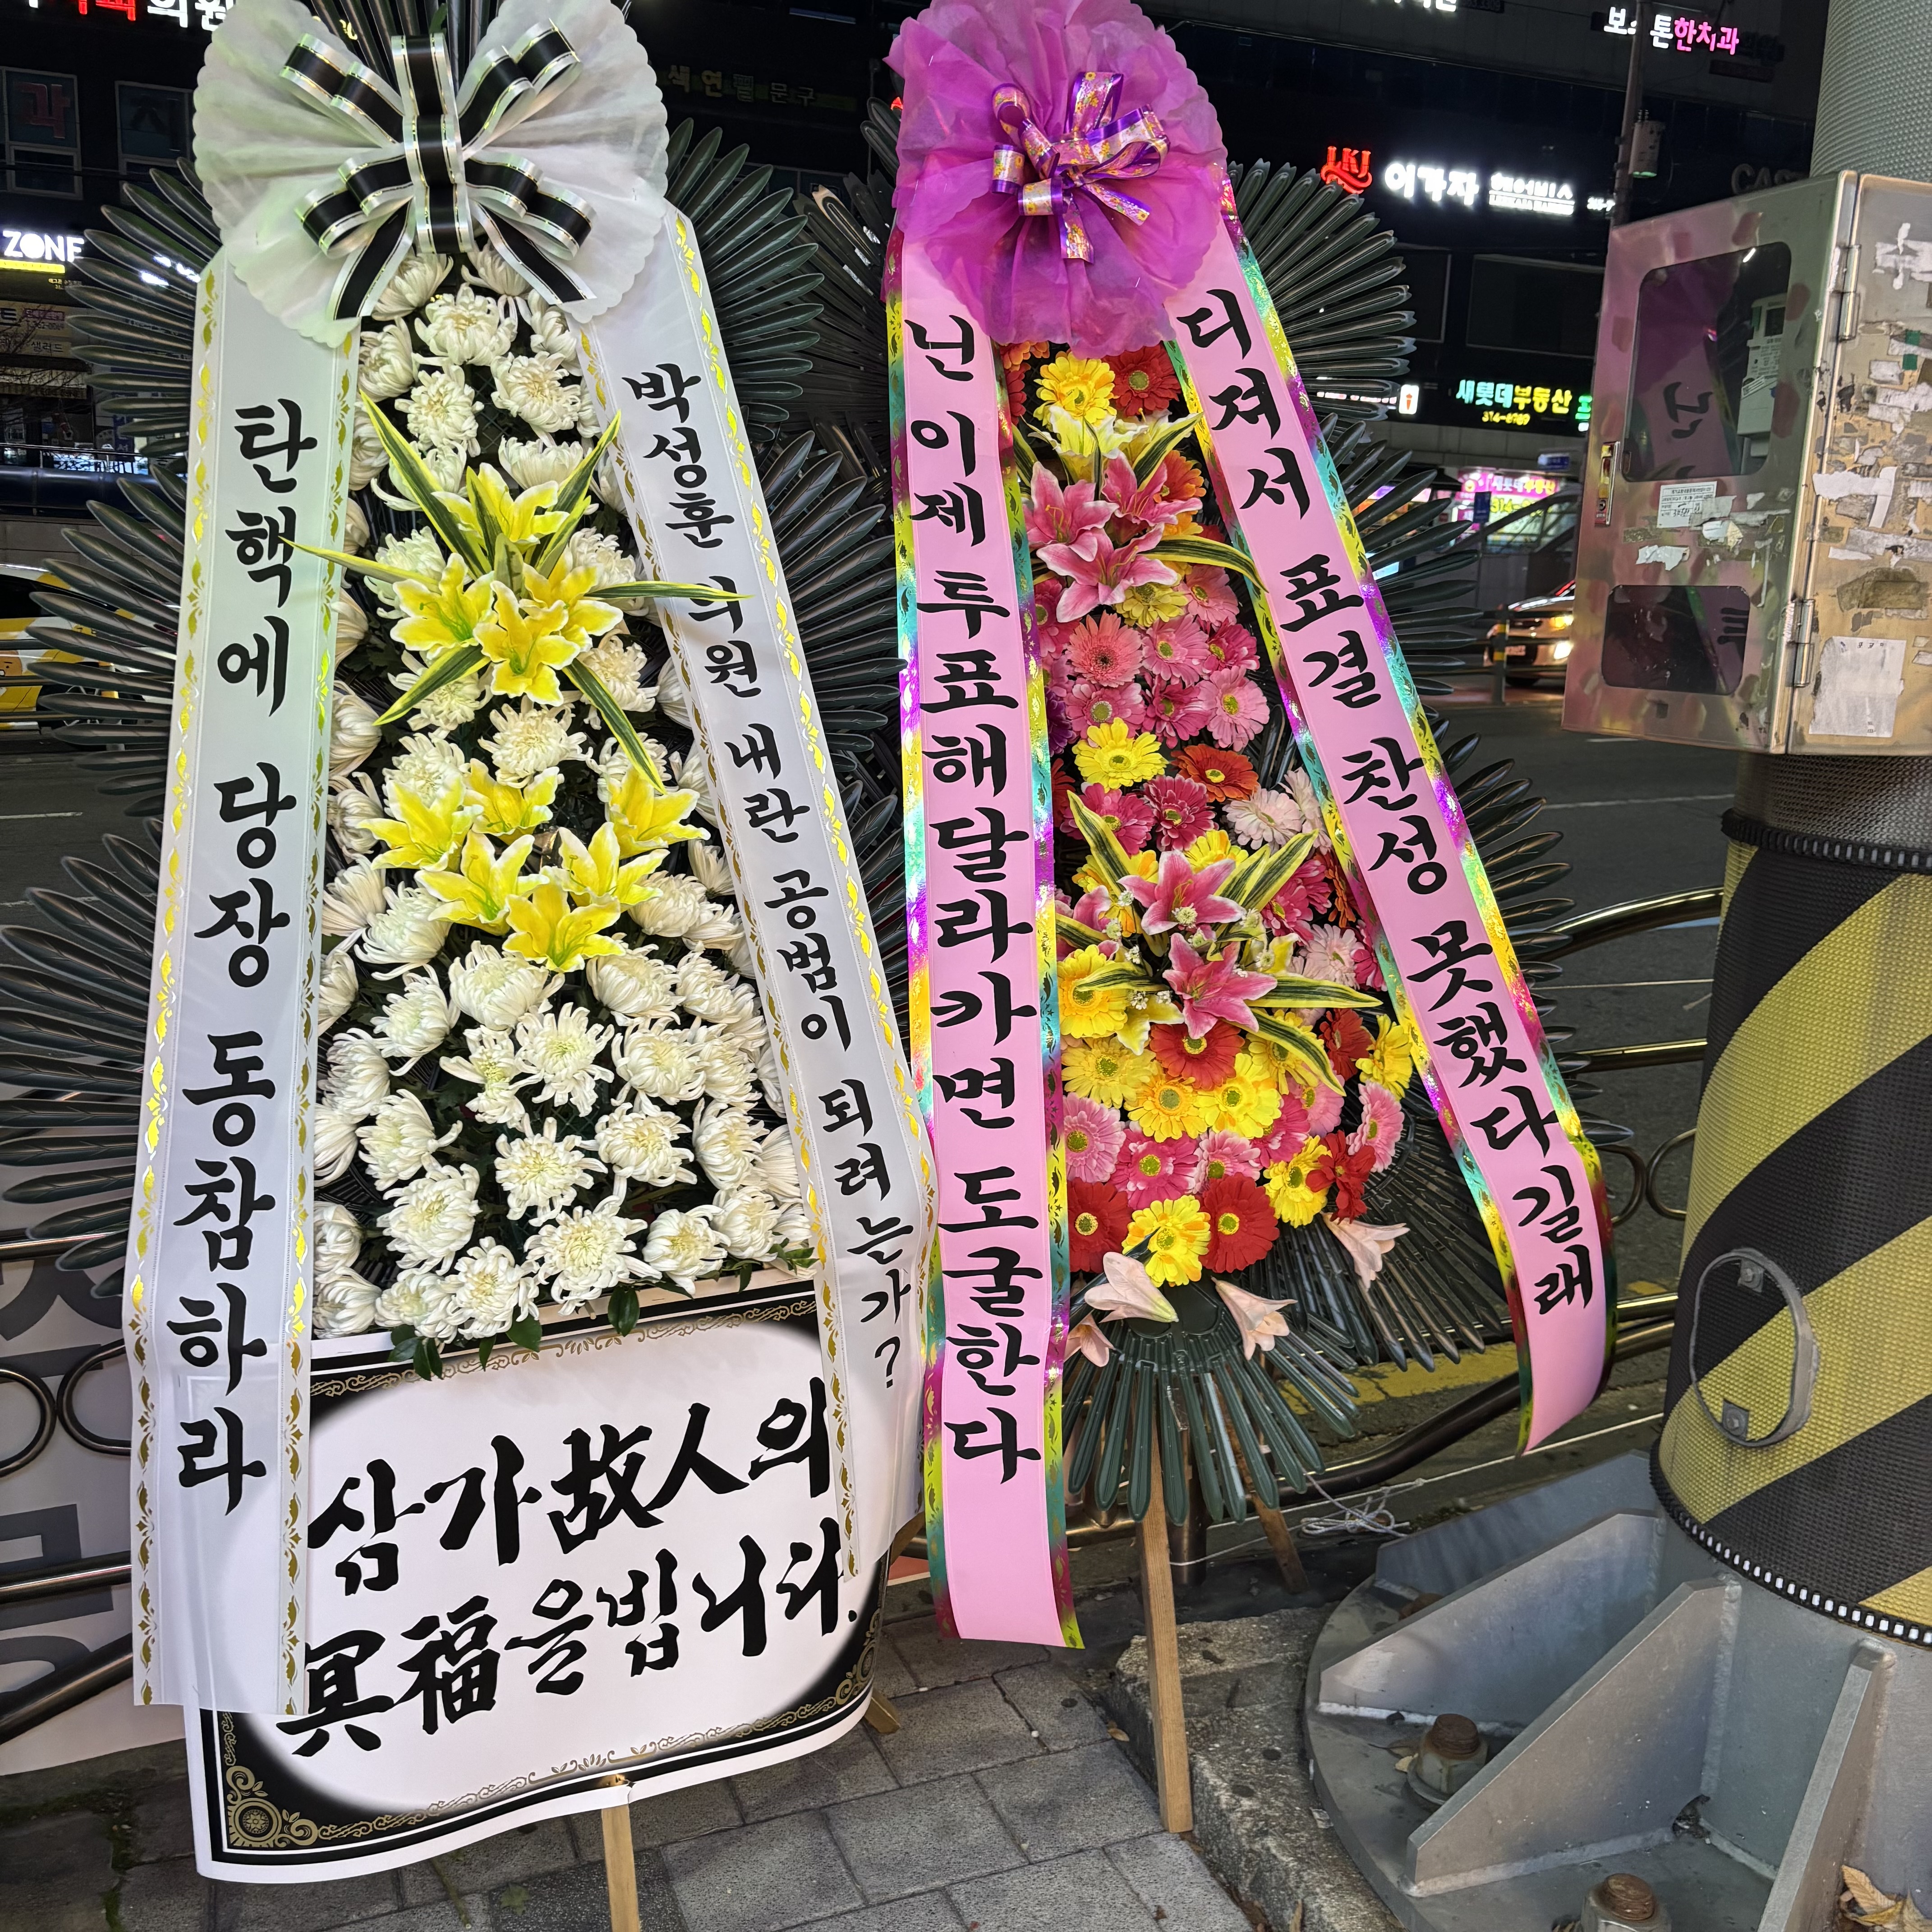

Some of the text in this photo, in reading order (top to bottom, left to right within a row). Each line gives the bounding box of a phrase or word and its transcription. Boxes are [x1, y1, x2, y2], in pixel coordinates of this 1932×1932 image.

[31, 340, 64, 353] 샐러드
[904, 315, 975, 381] 넌
[1455, 379, 1573, 414] 새롯데부동산
[910, 411, 986, 547] 이제
[1177, 289, 1309, 519] 디져서
[1280, 554, 1382, 708] 표결
[1342, 737, 1448, 895] 찬성
[167, 398, 317, 1516] 탄핵에 당장 동참하라
[622, 363, 913, 1389] 박성훈 의원 내란 공범이 되려는가?
[938, 1166, 1043, 1484] 도굴한다
[308, 1435, 542, 1596] 삼가
[547, 1377, 830, 1555] 故人의
